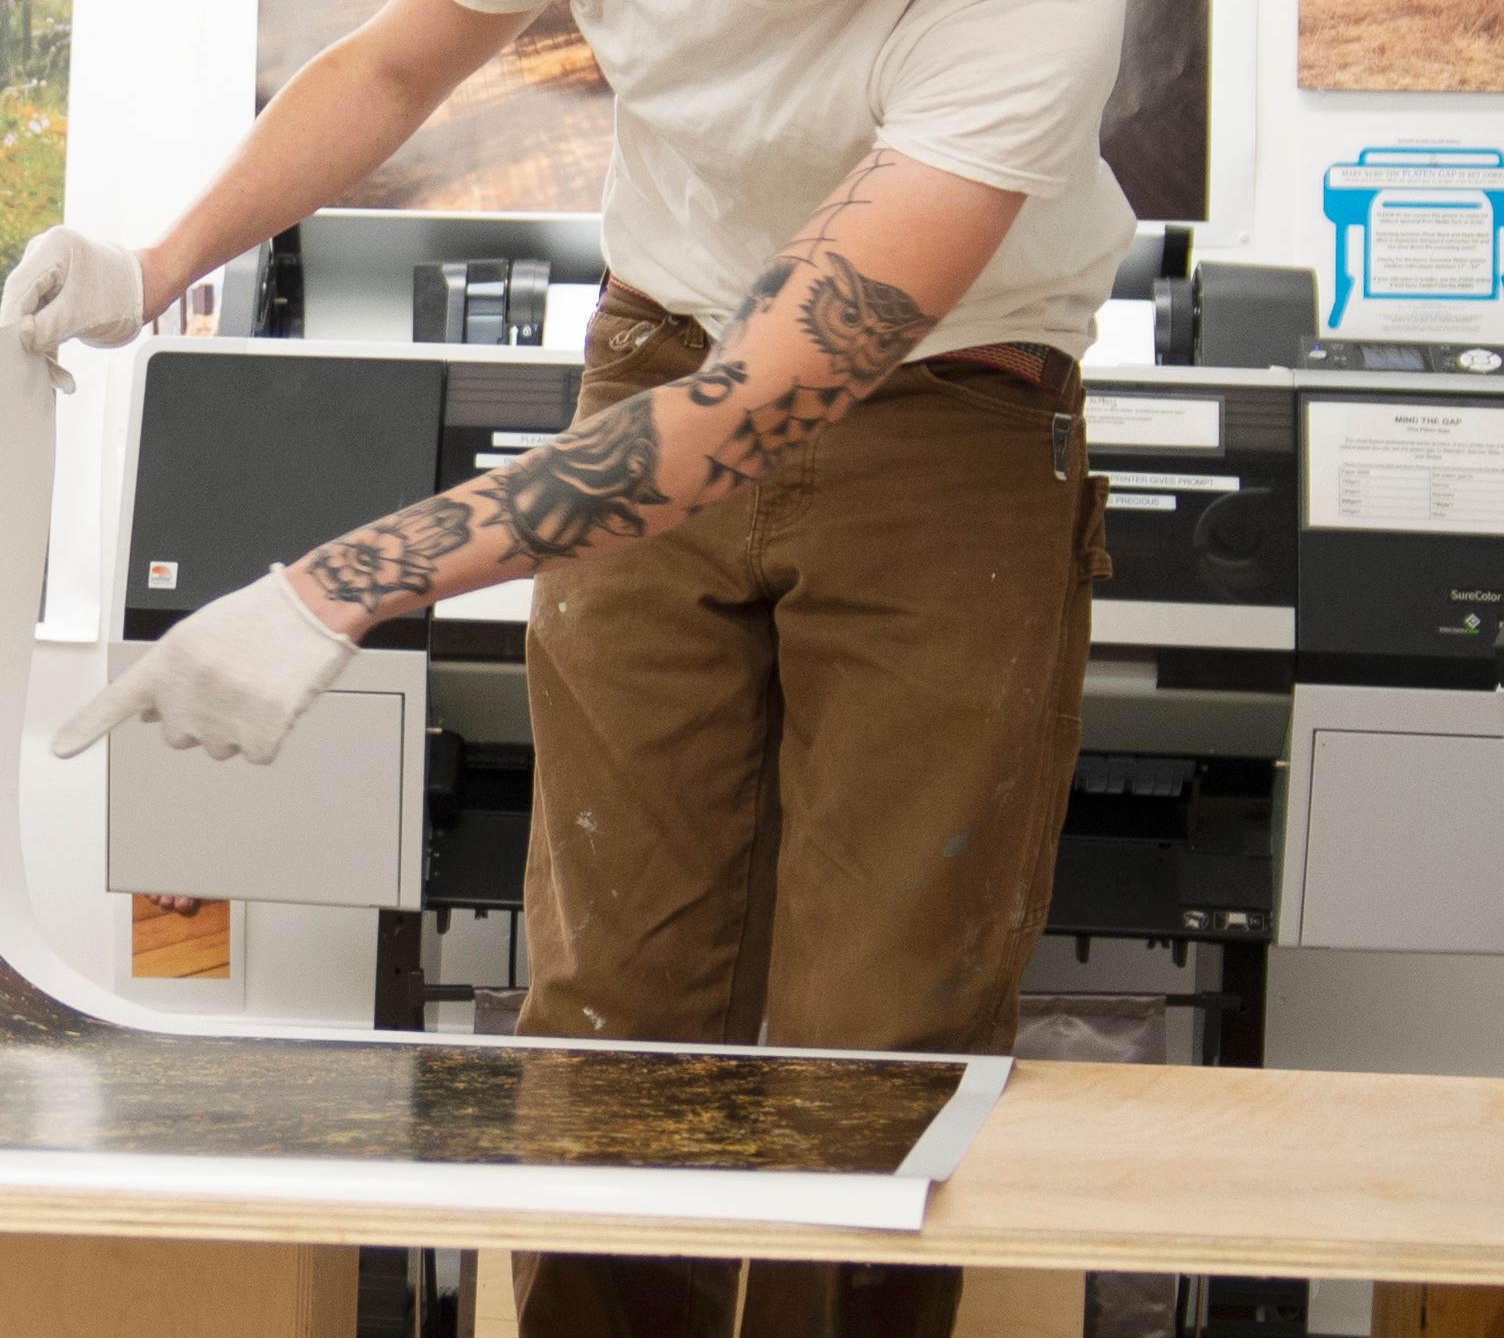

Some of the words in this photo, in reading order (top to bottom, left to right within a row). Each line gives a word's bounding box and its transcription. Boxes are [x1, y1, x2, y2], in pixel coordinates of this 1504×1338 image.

[1395, 416, 1418, 424] MIND
[1422, 417, 1437, 425] THE
[1442, 417, 1462, 426] GAP
[1110, 476, 1148, 484] PRINTER
[1150, 477, 1176, 485] GIVES
[1177, 478, 1214, 486] PROMPT
[1115, 498, 1159, 506] PRECIOUS
[1451, 589, 1501, 602] SureColor
